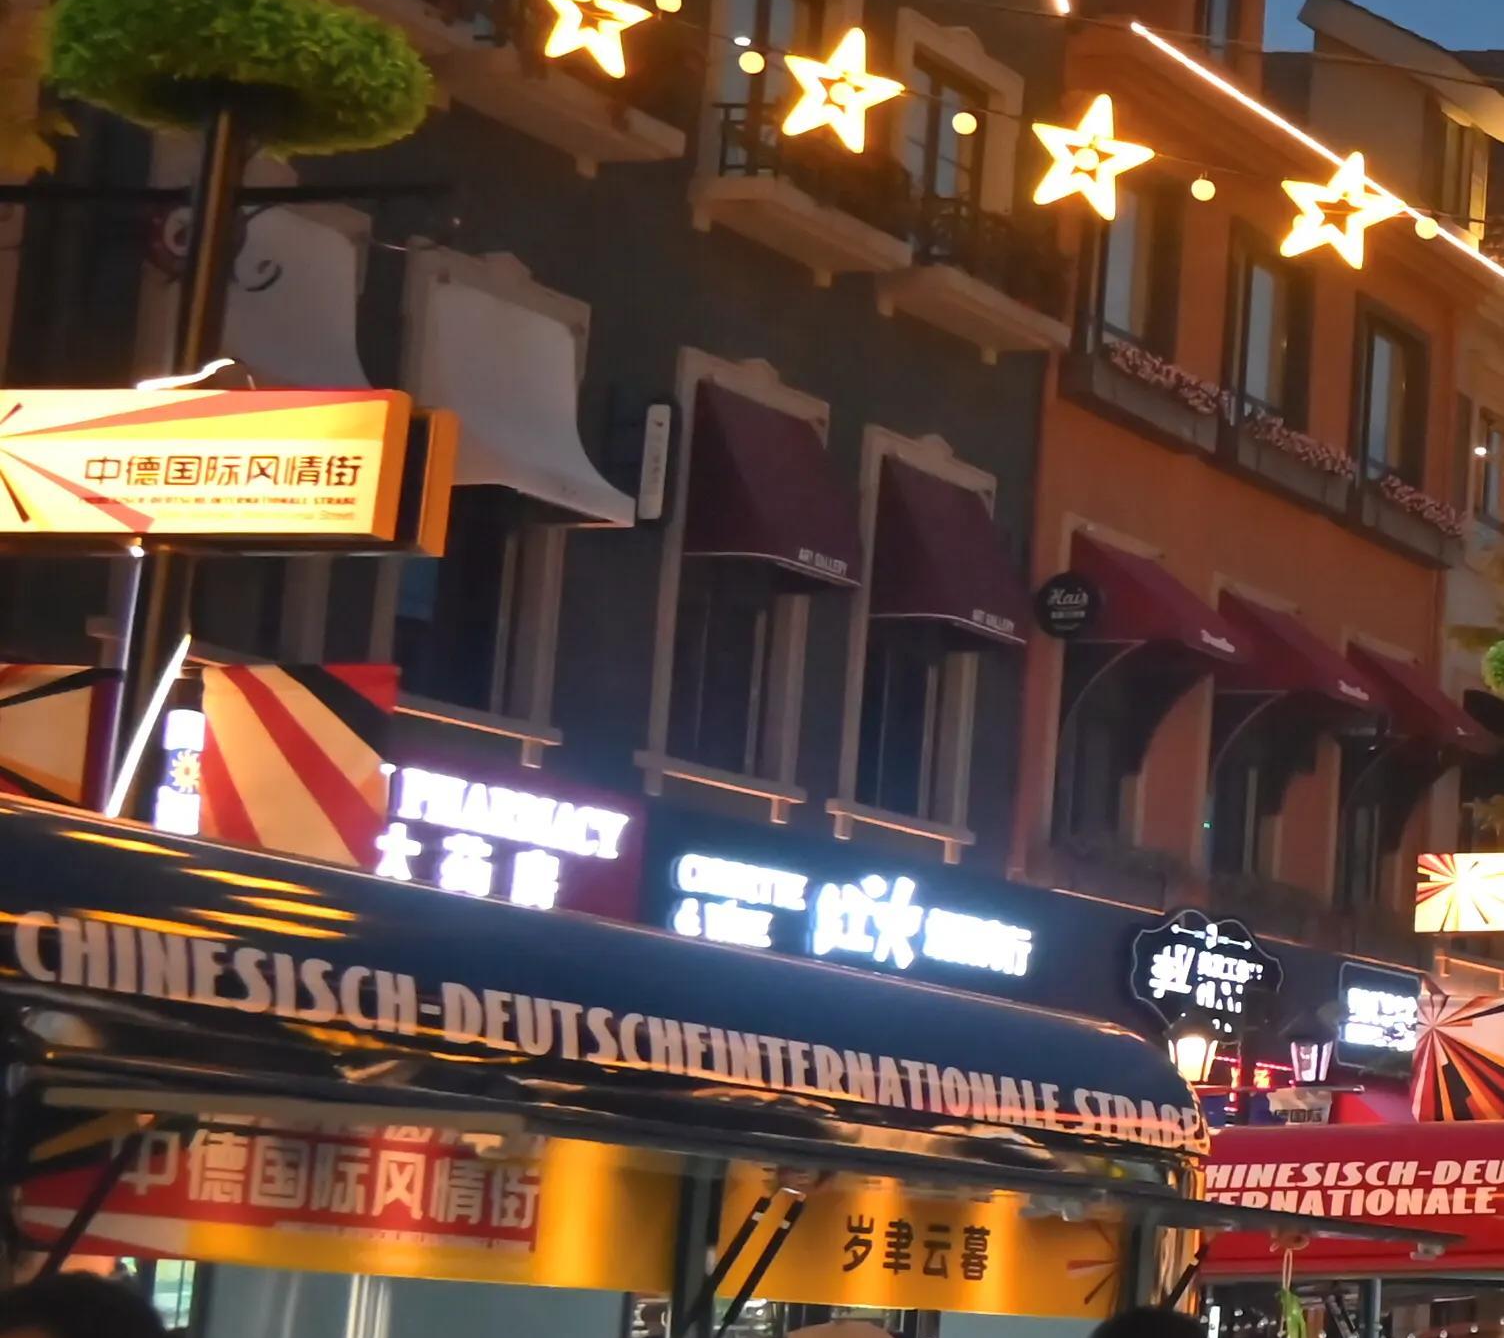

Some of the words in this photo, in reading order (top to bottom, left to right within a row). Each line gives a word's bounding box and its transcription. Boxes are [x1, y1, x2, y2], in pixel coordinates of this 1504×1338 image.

[84, 455, 363, 487] 中德国际风情街
[111, 1128, 541, 1229] 中德国际风情街
[842, 1214, 991, 1282] 岁聿云暮
